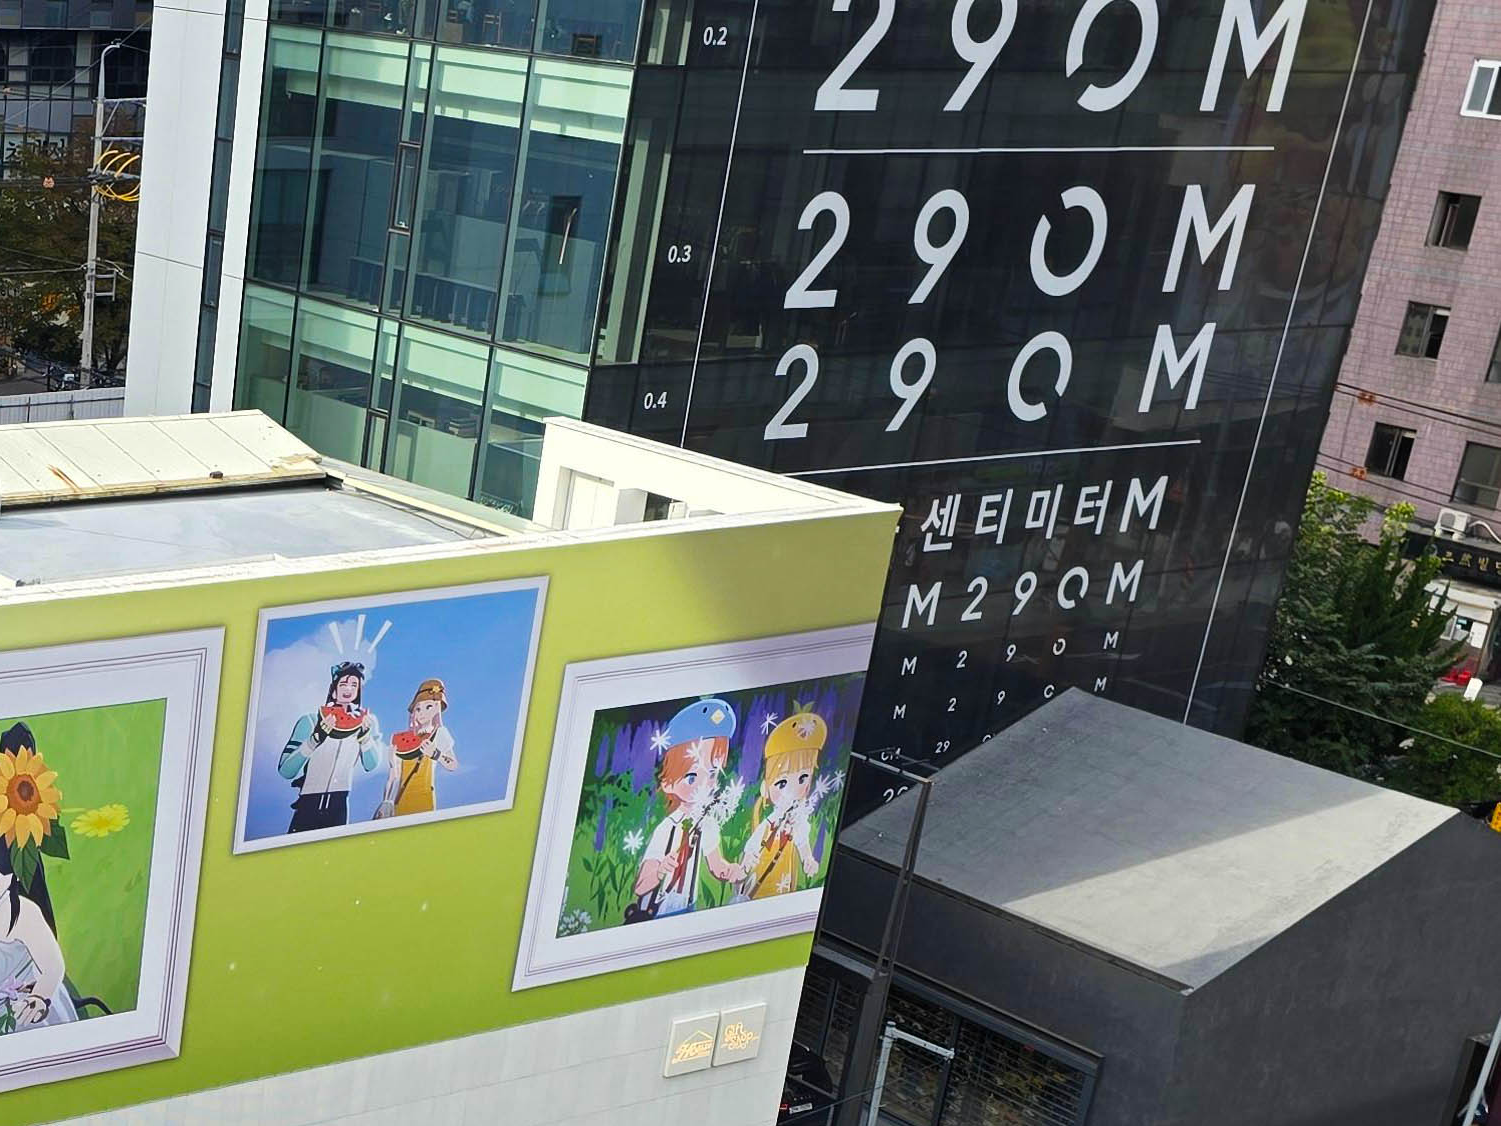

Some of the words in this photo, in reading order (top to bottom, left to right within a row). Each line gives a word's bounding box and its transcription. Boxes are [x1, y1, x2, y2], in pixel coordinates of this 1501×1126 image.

[703, 27, 727, 46] 0.2
[668, 245, 692, 264] 0.3
[643, 392, 667, 410] 0.4
